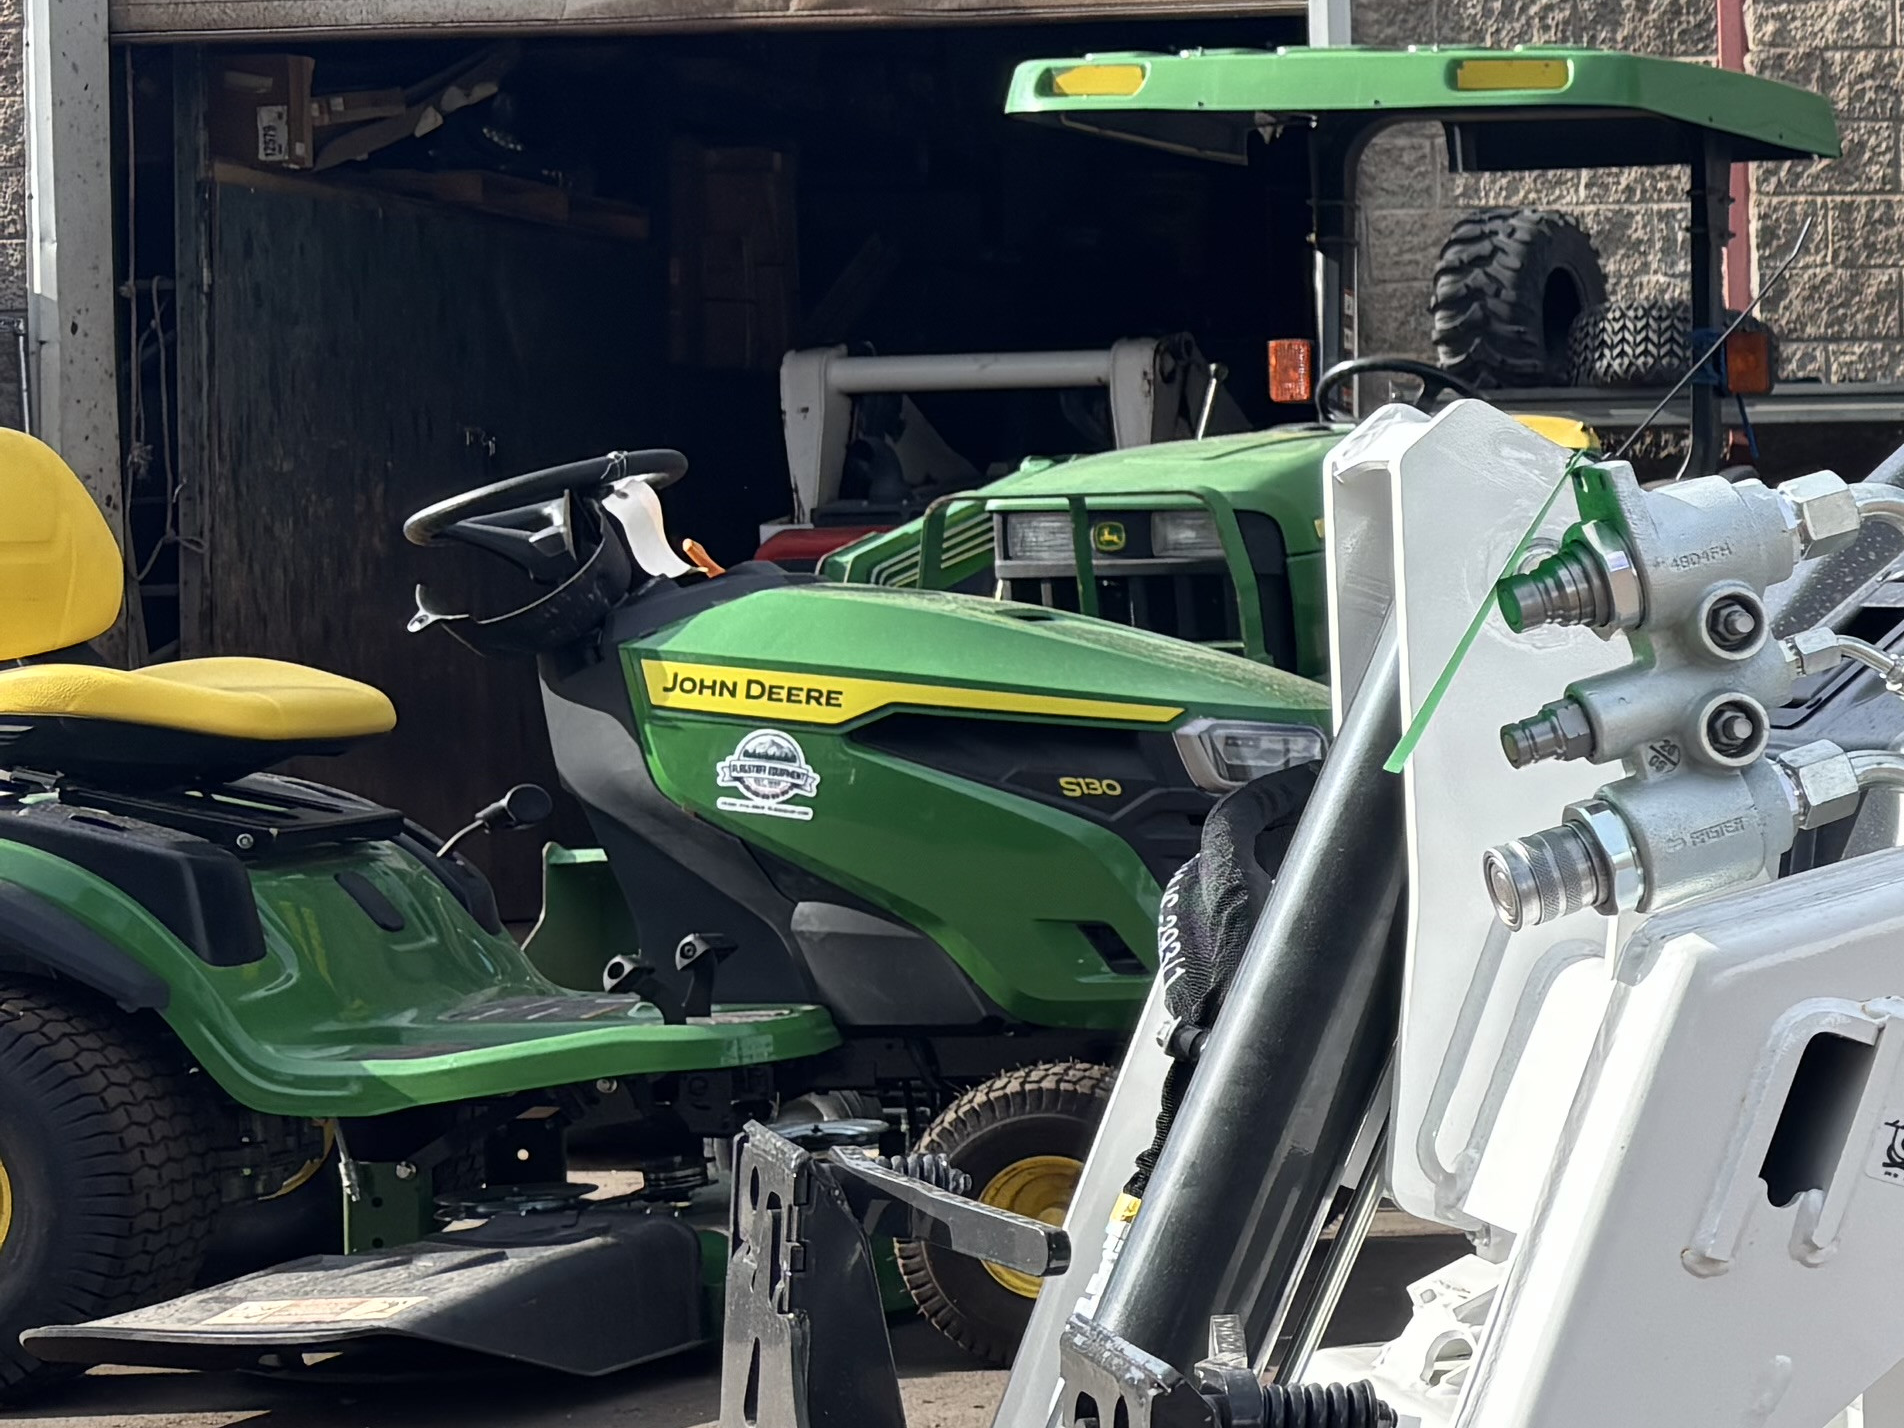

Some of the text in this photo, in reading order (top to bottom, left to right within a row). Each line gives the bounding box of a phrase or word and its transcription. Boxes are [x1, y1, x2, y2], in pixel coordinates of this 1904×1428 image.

[662, 672, 843, 708] JOHN DEERE
[1059, 776, 1122, 798] S130
